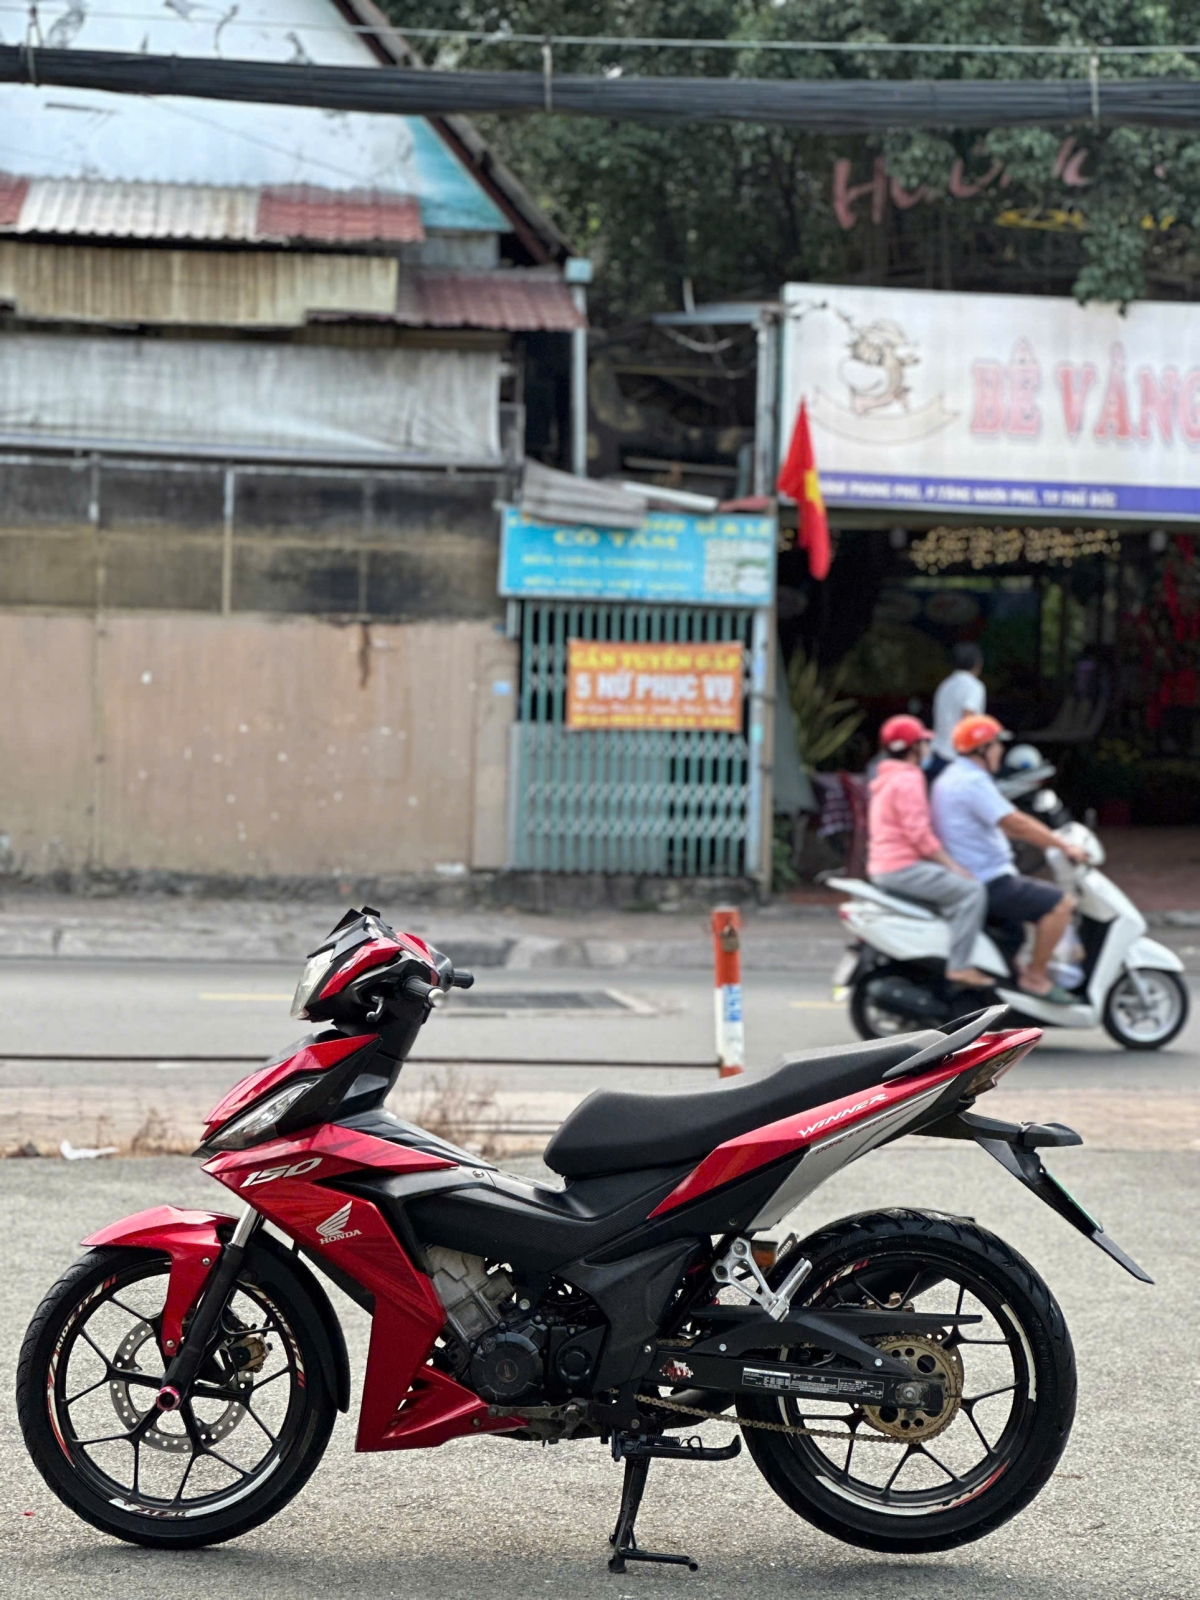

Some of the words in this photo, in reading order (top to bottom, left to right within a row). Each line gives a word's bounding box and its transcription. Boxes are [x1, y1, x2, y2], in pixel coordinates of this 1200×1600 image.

[797, 1092, 888, 1137] WINNER
[239, 1158, 323, 1188] 150
[319, 1229, 362, 1245] HONDA
